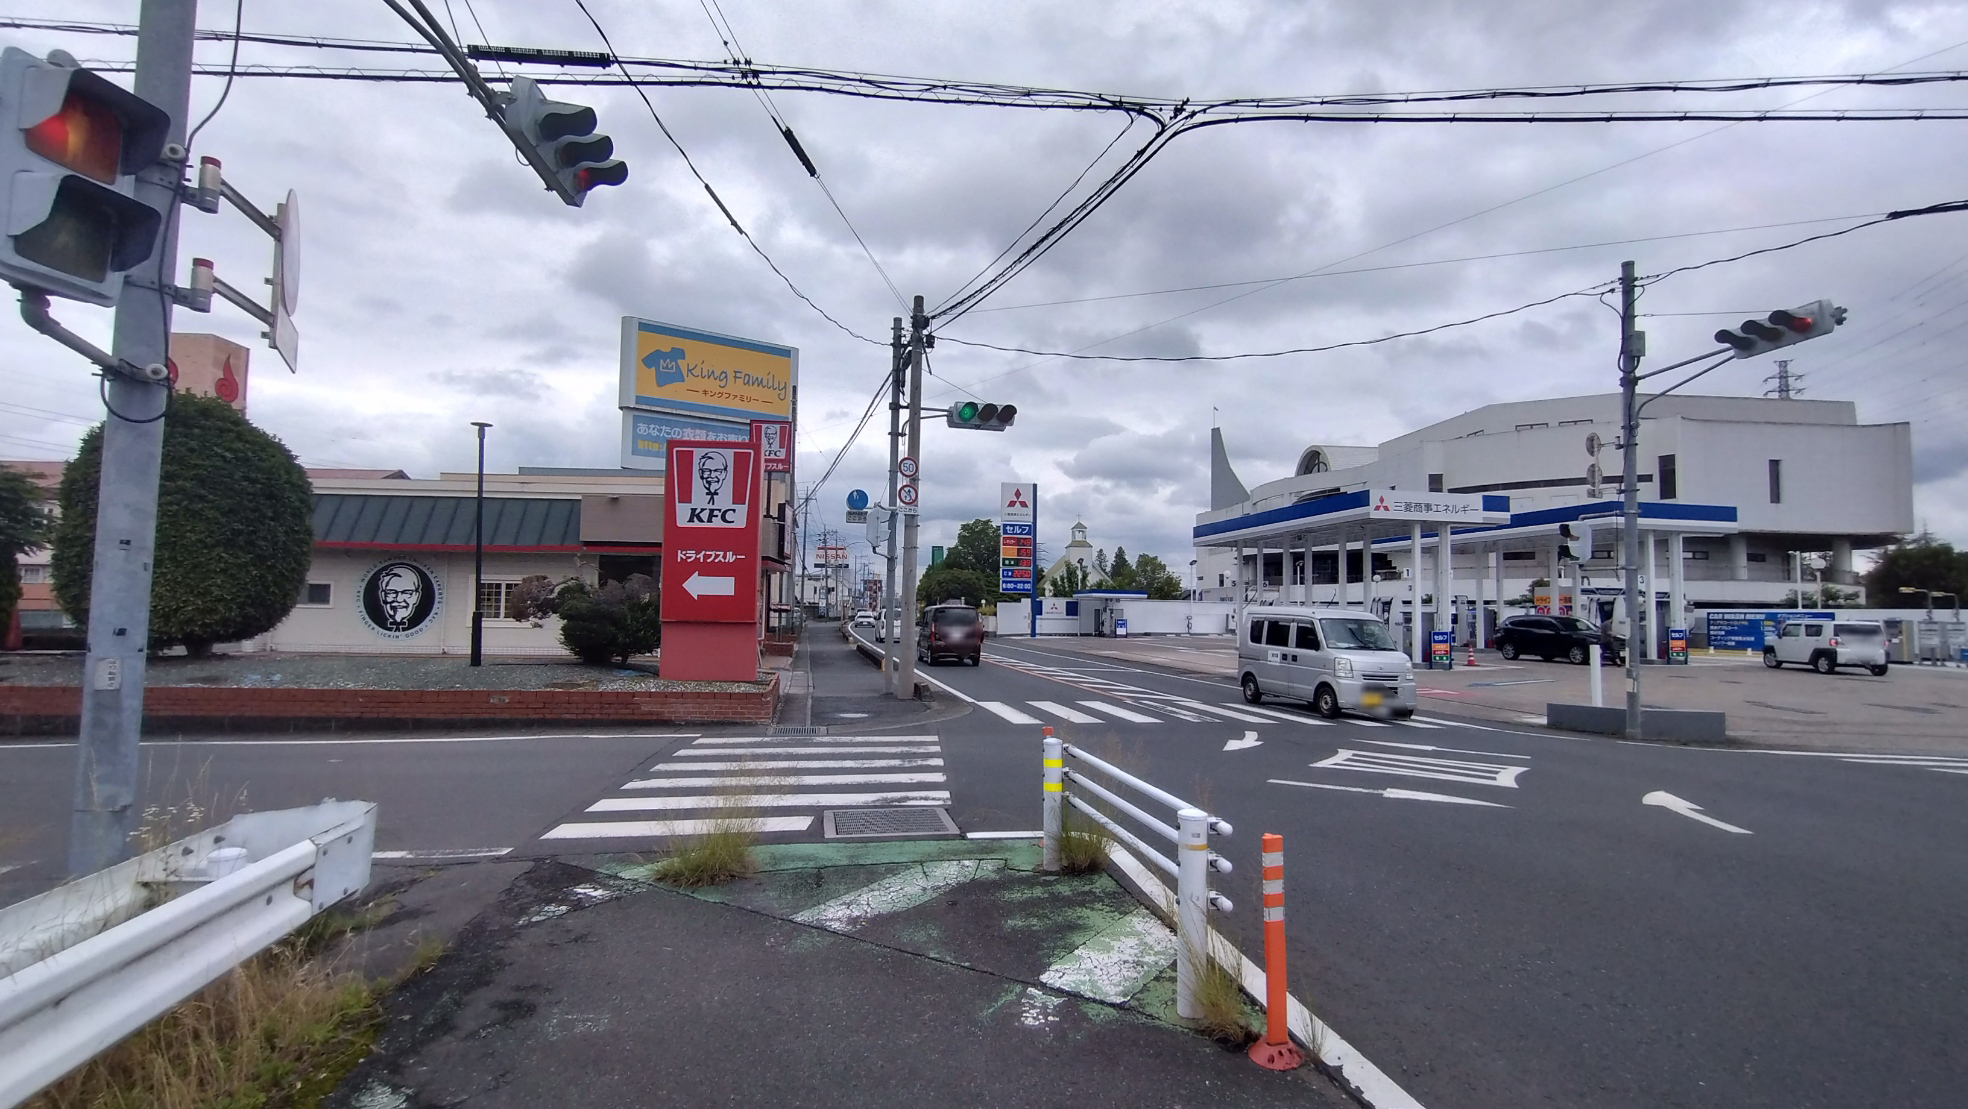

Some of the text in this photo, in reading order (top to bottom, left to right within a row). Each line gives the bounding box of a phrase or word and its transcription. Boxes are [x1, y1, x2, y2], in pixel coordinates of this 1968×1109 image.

[686, 359, 787, 401] King Family
[702, 389, 760, 403] キングファミリー
[902, 462, 915, 473] 50
[1393, 501, 1479, 514] 三菱商事エネルギー
[686, 507, 736, 524] KFC
[1005, 525, 1030, 534] セルフ
[677, 550, 746, 563] ドライブスルー
[1639, 576, 1645, 584] 3
